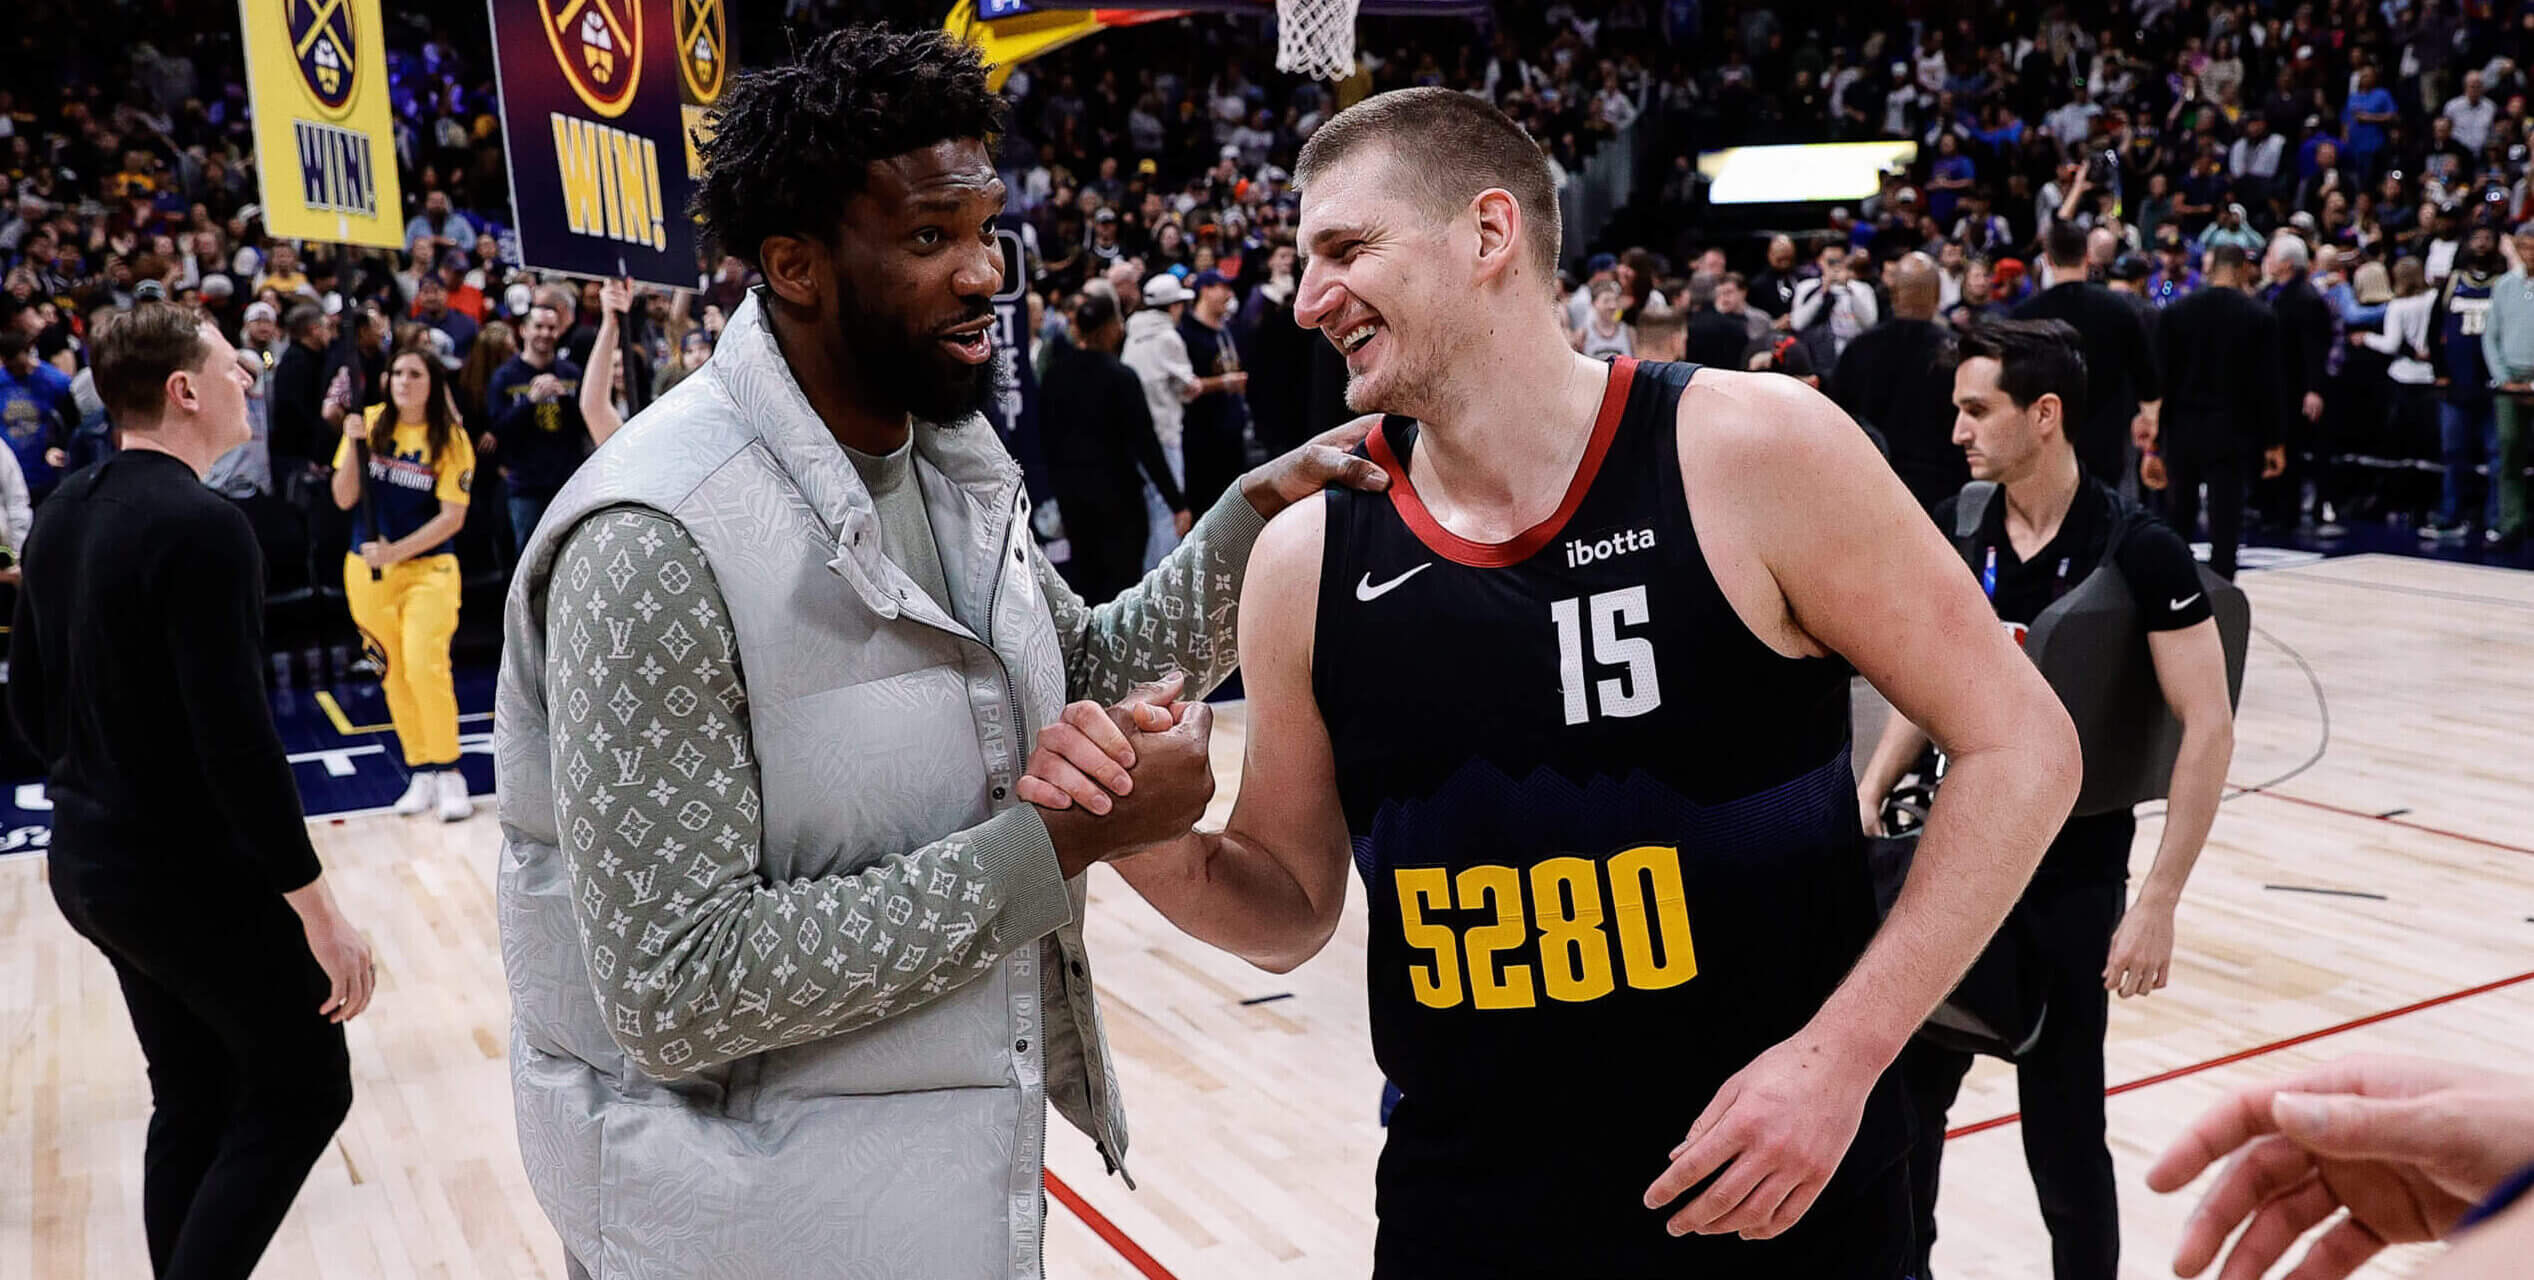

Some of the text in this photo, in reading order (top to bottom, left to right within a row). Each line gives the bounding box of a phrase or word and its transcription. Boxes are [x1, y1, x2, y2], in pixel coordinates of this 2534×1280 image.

[292, 117, 377, 218] WIN!
[551, 112, 666, 253] WIN!
[1566, 526, 1656, 569] ibotta
[1551, 585, 1661, 726] 15
[1394, 846, 1698, 1010] 5280
